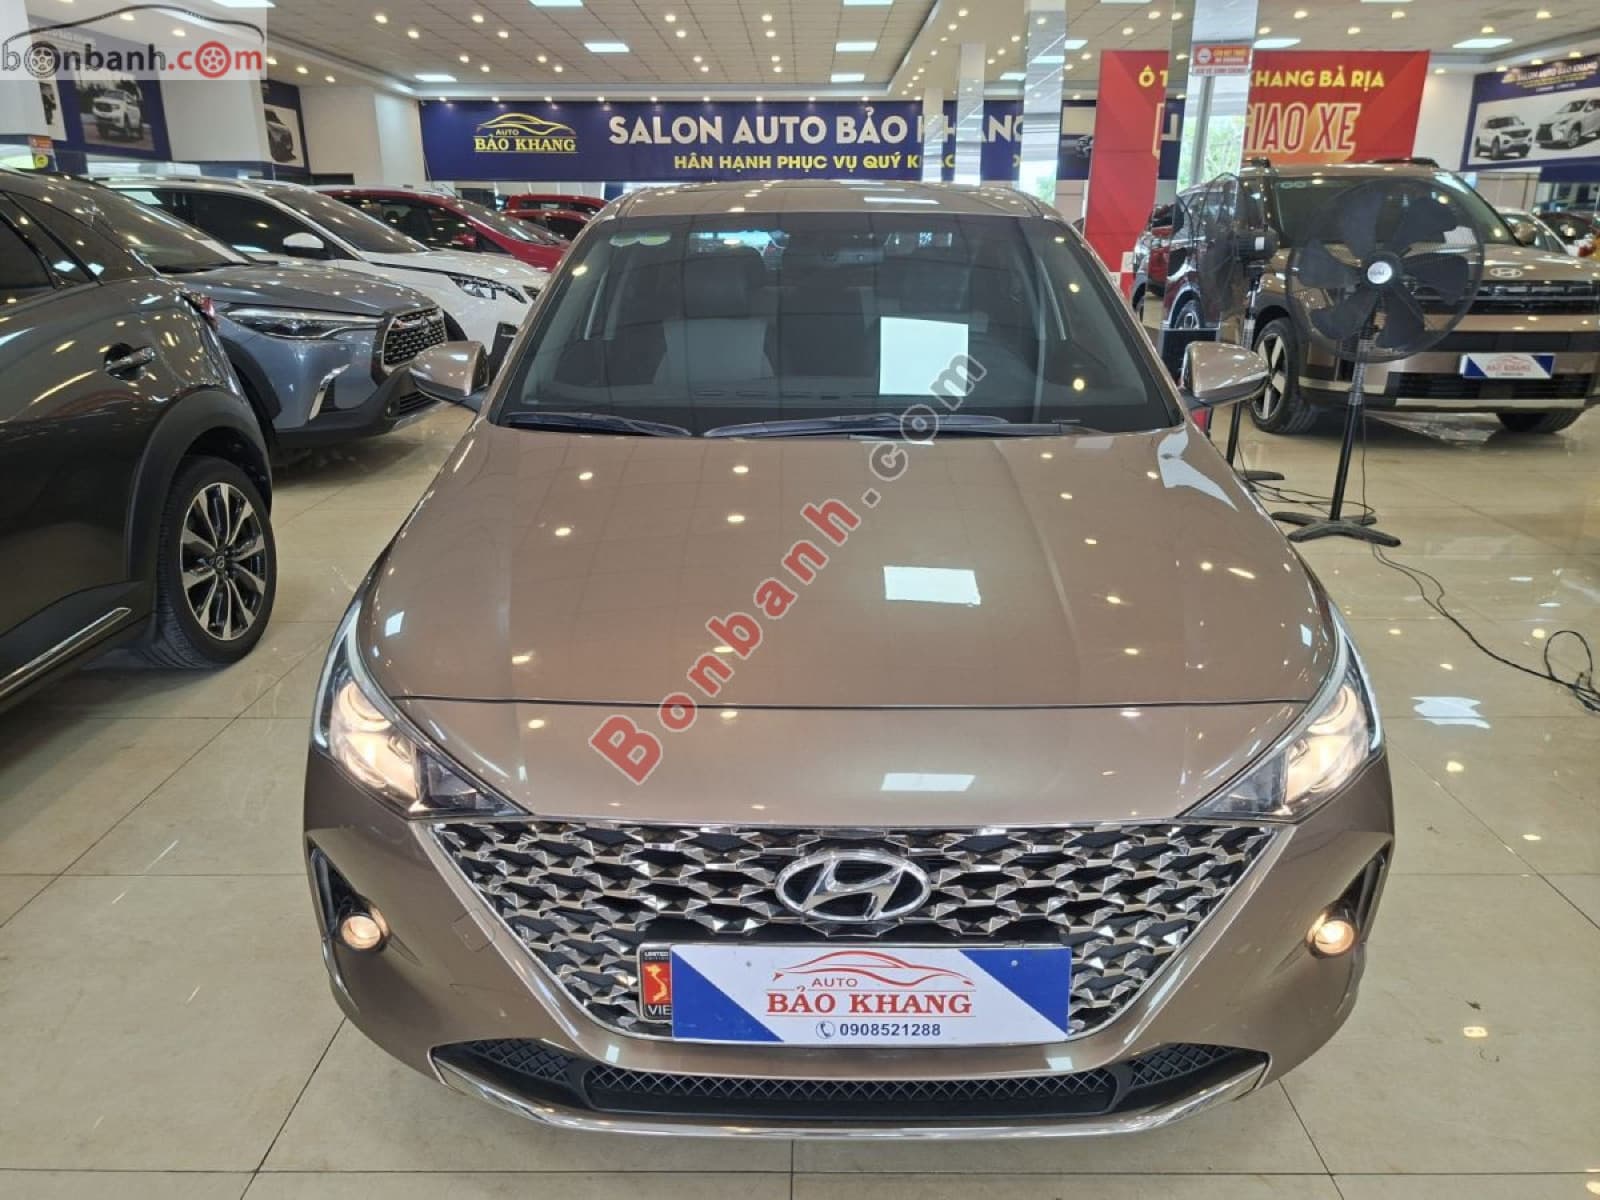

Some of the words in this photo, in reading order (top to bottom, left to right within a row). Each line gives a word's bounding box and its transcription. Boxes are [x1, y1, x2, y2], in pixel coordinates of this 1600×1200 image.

[1138, 65, 1156, 88] Ô
[1350, 70, 1385, 92] RỊA
[609, 116, 723, 144] SALON
[732, 116, 827, 144] AUTO
[836, 106, 908, 144] BẢO
[1311, 102, 1362, 154] XE
[474, 134, 509, 150] BẢO
[515, 138, 576, 151] KHANG
[674, 152, 713, 169] HÂN
[719, 155, 771, 173] HẠNH
[777, 155, 827, 173] PHỤC
[833, 155, 857, 173] VỤ
[863, 151, 901, 168] QUÝ
[812, 978, 858, 988] AUTO
[767, 986, 836, 1013] BẢO
[849, 993, 972, 1015] KHANG
[839, 1023, 941, 1037] 0908521288
